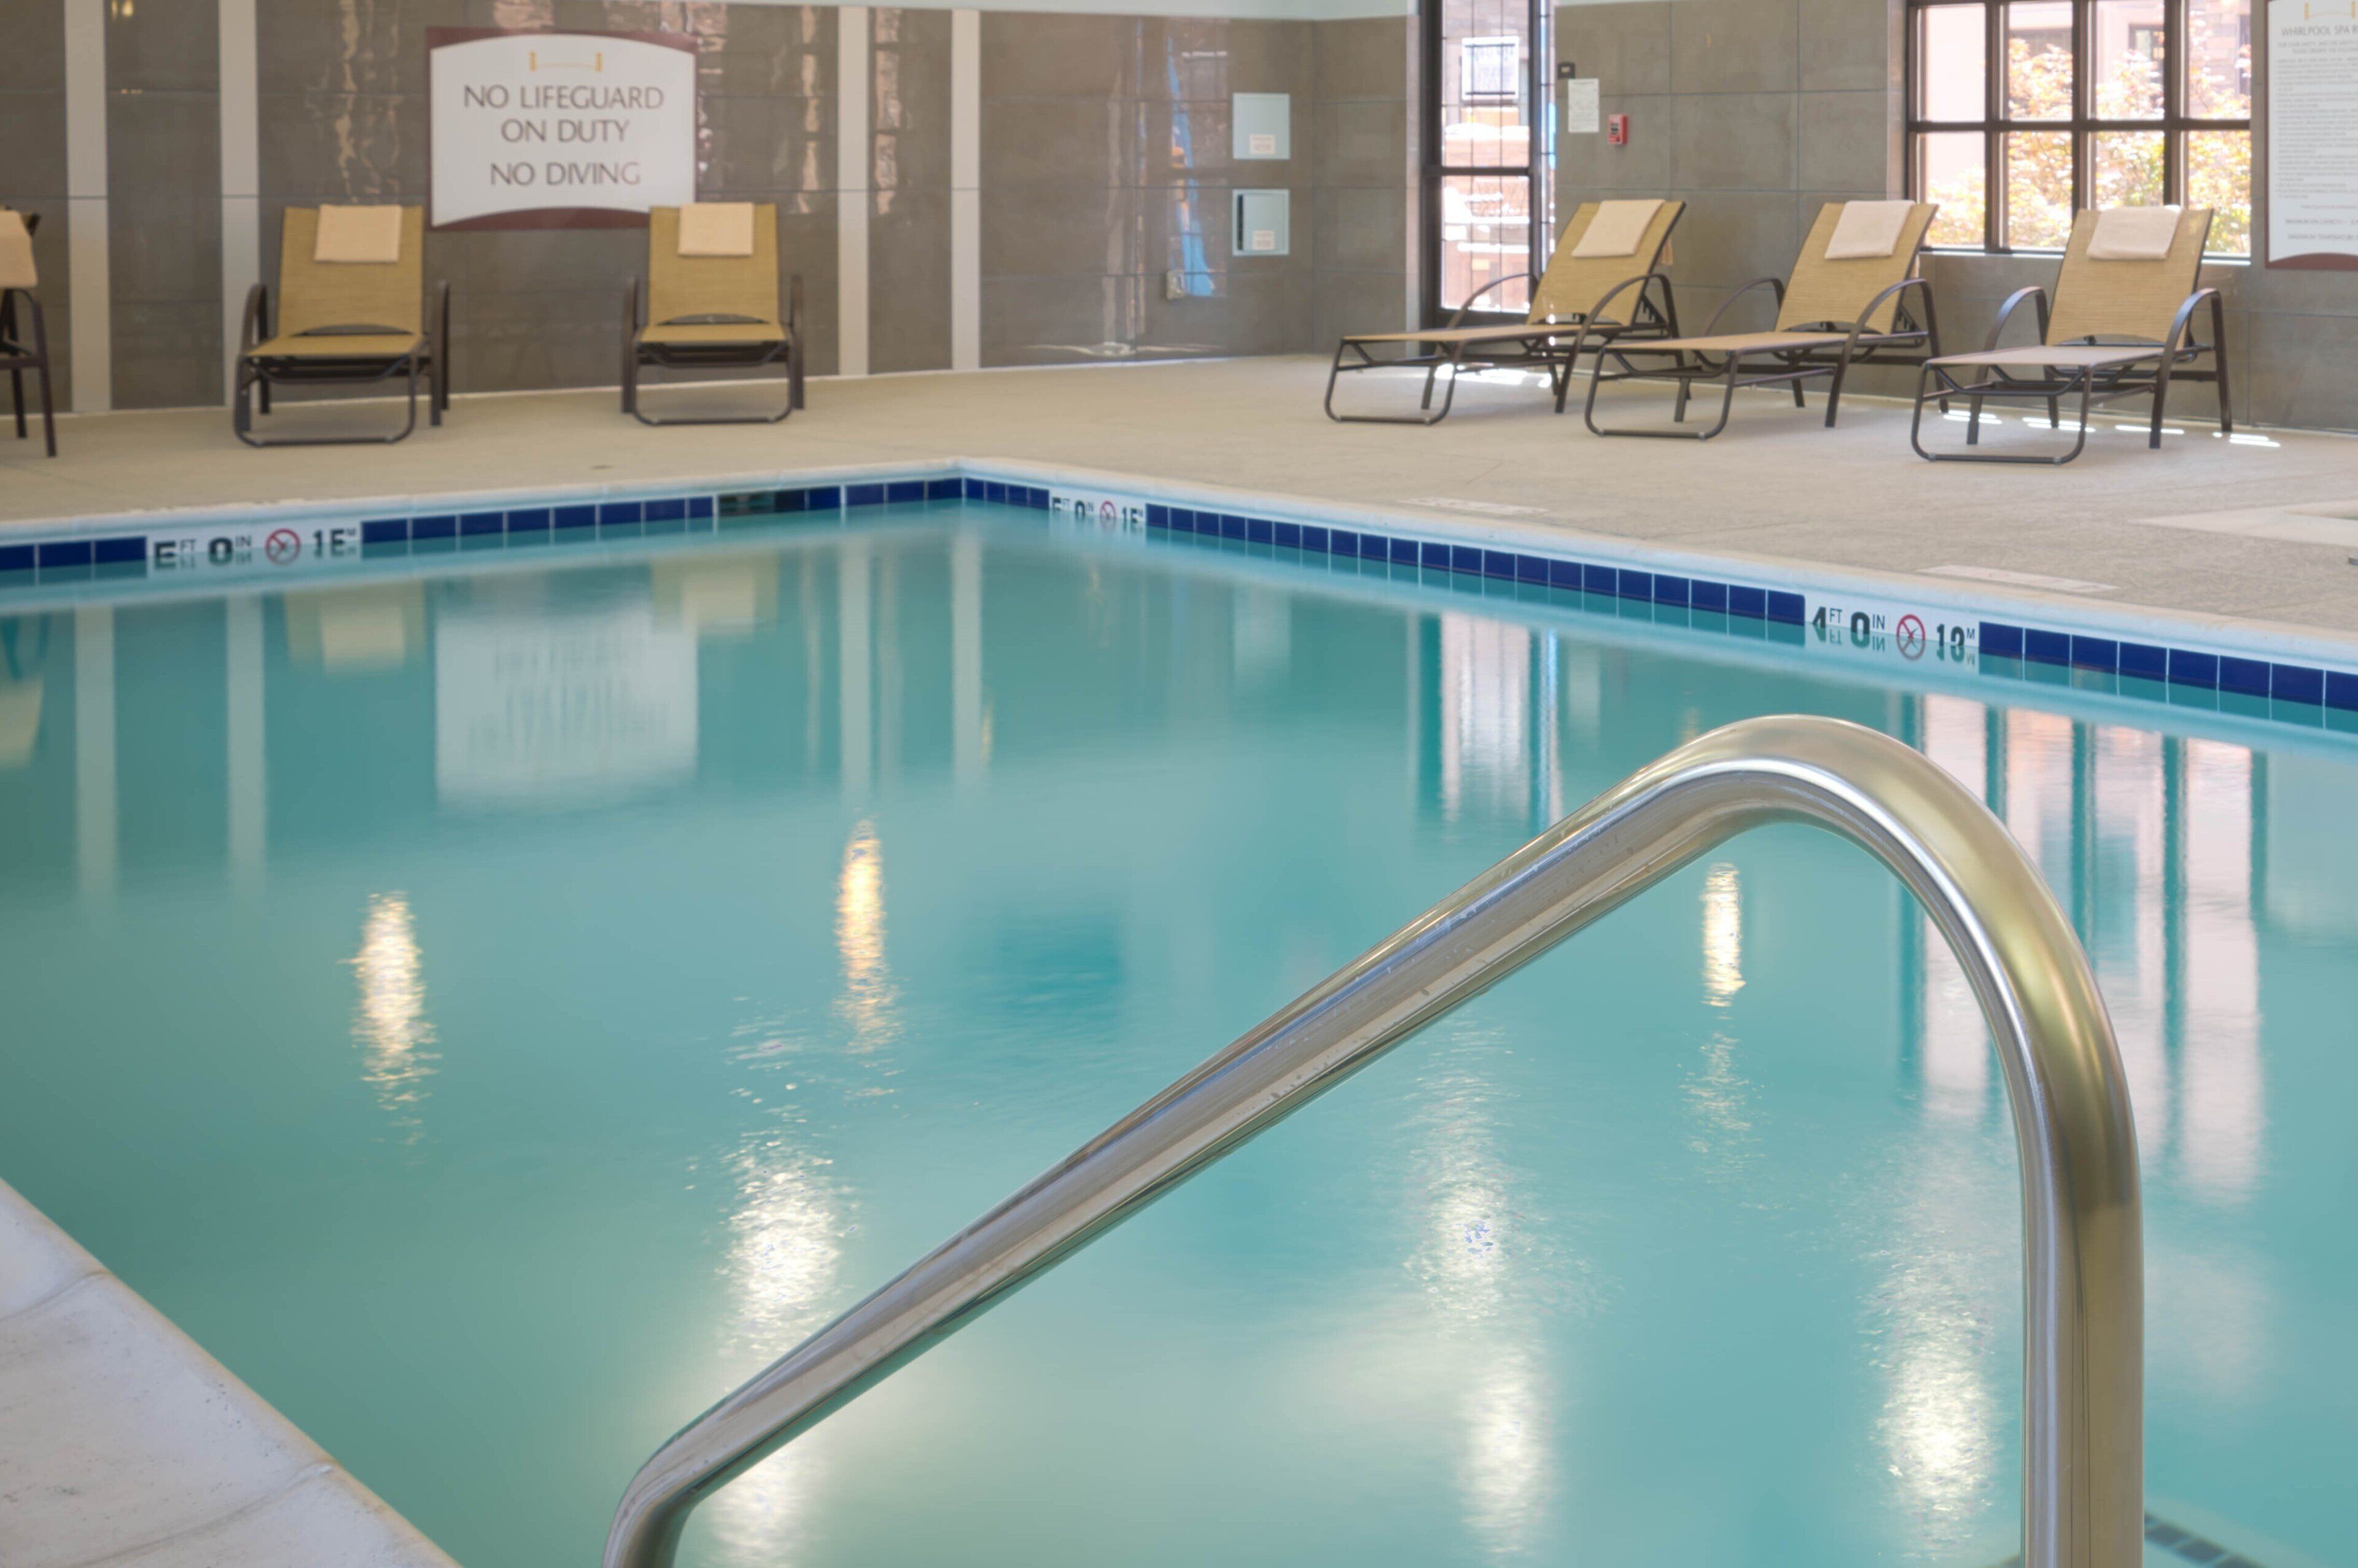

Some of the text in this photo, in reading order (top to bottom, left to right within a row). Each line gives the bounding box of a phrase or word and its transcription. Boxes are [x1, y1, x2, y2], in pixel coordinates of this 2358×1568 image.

[464, 85, 664, 109] NO LIFEGUARD
[501, 118, 629, 142] ON DUTY
[490, 162, 640, 185] NO DIVING
[1829, 608, 1843, 623] FT
[1872, 614, 1885, 630] IN
[1966, 627, 1975, 640] M
